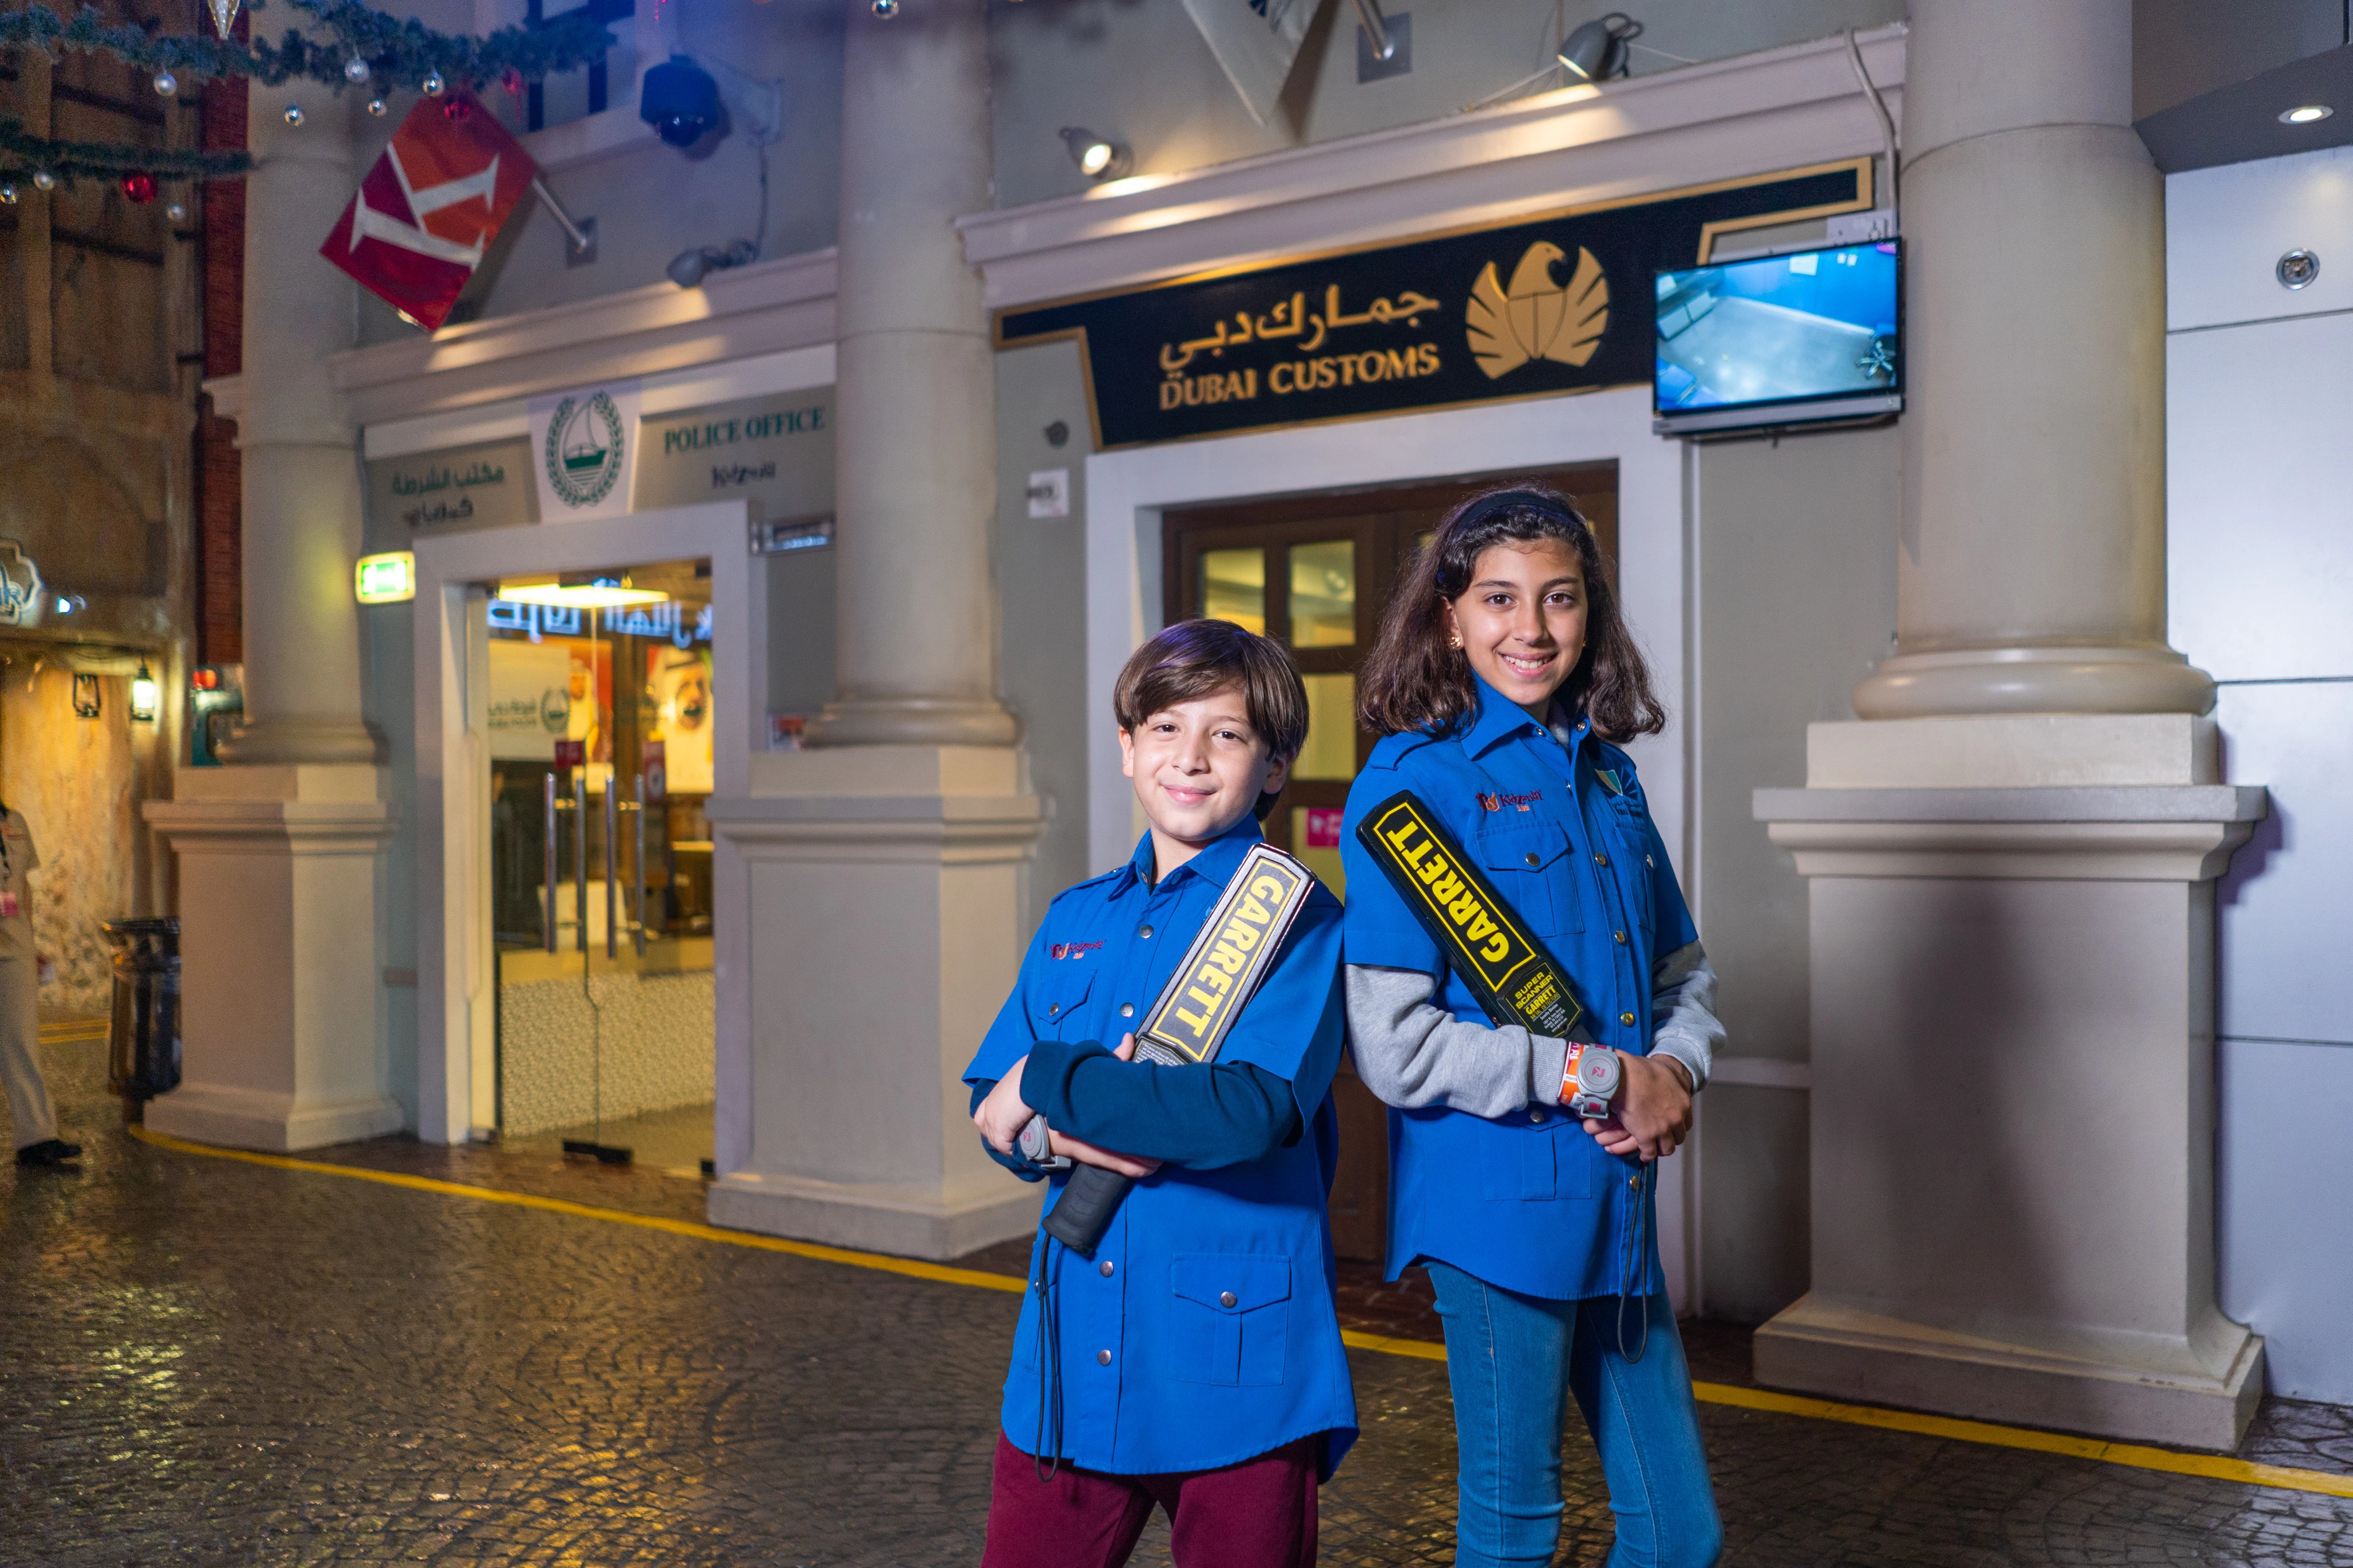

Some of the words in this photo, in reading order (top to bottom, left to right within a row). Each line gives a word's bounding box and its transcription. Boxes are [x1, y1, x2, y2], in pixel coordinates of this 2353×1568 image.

[1159, 311, 1254, 379] دبي
[1256, 284, 1440, 351] جمارك
[1159, 368, 1257, 410] DUBAI
[1268, 342, 1441, 394] CUSTOMS
[664, 418, 740, 454] POLICE
[746, 405, 826, 439] OFFICE
[1386, 820, 1510, 963] GARRETT
[1175, 875, 1285, 1037] GARRETT
[1515, 971, 1545, 999] SUPER
[1525, 984, 1556, 1015] GARRETT
[1530, 1009, 1541, 1019] METAL
[1541, 992, 1559, 1009] DETECTORS
[1540, 1011, 1549, 1019] Security
[1548, 1003, 1558, 1011] Division
